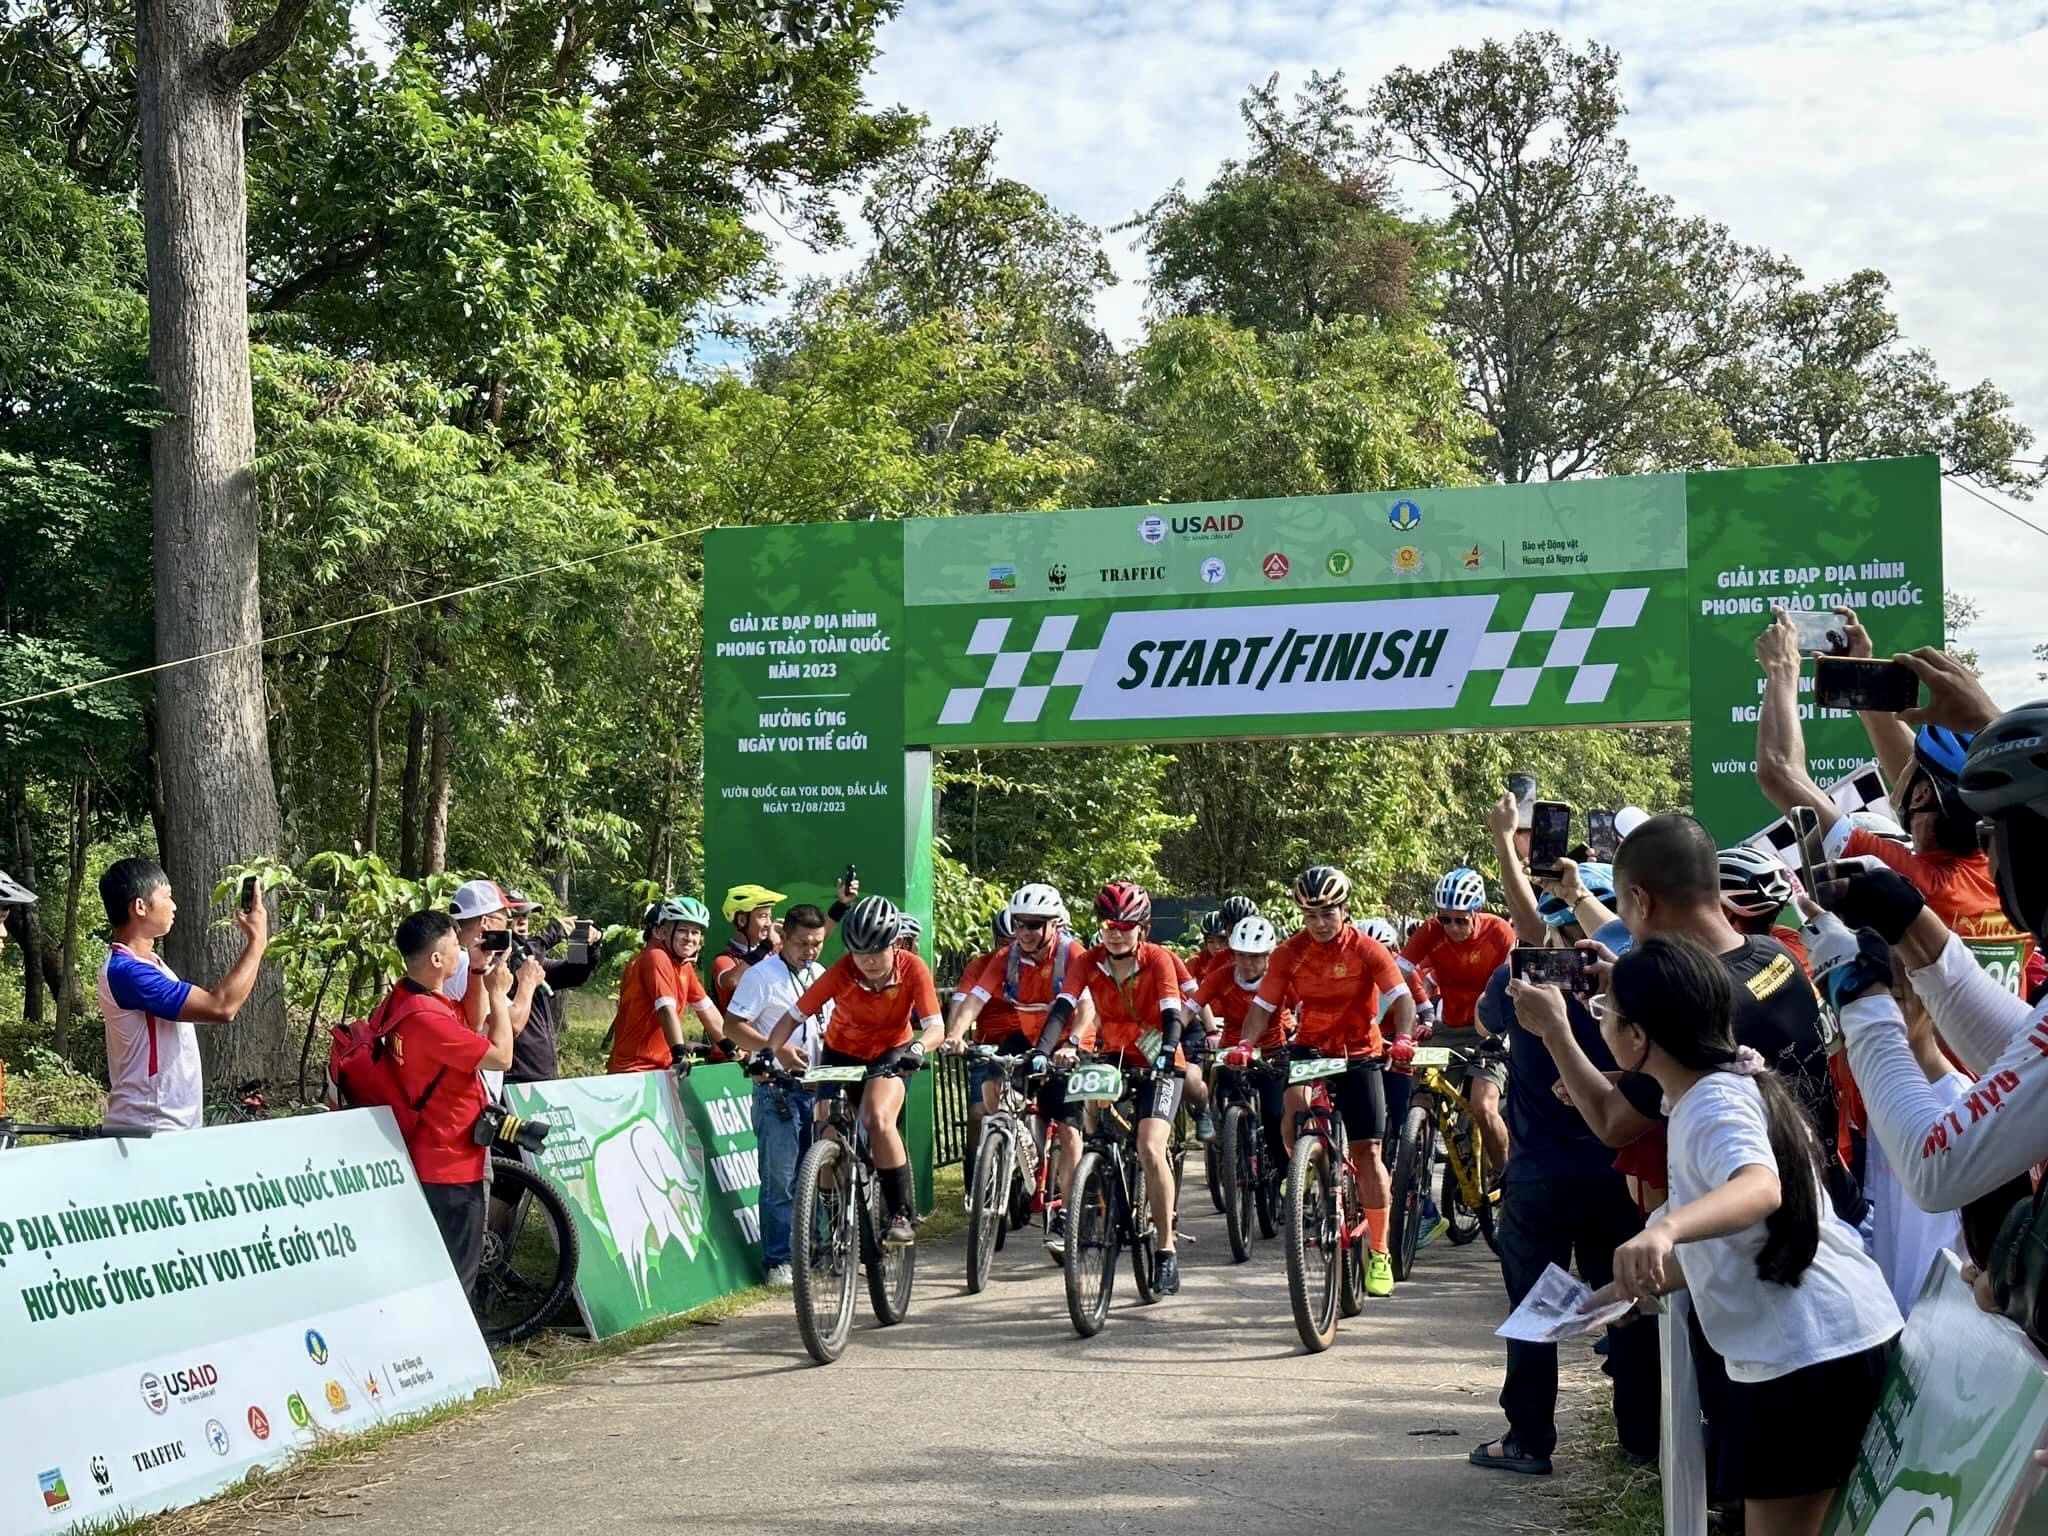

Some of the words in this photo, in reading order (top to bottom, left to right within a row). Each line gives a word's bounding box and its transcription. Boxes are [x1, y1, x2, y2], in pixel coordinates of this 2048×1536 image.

[1171, 514, 1244, 534] USAID
[1100, 566, 1166, 582] TRAFFIC
[1718, 565, 1753, 588] GIẢI
[1758, 569, 1779, 586] XE
[1784, 567, 1820, 589] ĐẠP
[1825, 565, 1856, 586] ĐỊA
[1860, 558, 1904, 580] HÌNH
[1701, 597, 1763, 616] PHONG
[1819, 588, 1867, 608] TOÀN
[1871, 581, 1923, 609] QUỐC
[730, 612, 758, 633] GIẢI
[762, 616, 778, 631] XE
[782, 615, 811, 634] ĐẠP
[814, 614, 839, 633] ĐỊA
[842, 609, 877, 628] HÌNH
[716, 641, 765, 657] PHONG
[768, 636, 806, 655] TRÀO
[810, 634, 847, 653] TOÀN
[850, 629, 891, 654] QUỐC
[769, 660, 800, 679] NĂM
[803, 663, 837, 678] 2023
[1116, 628, 1449, 691] START/FINISH
[759, 707, 811, 728] HƯỞNG
[815, 707, 846, 726] ỨNG
[738, 734, 776, 753] NGÀY
[779, 737, 803, 751] VOI
[806, 729, 835, 751] THẾ
[836, 731, 868, 750] GIỚI
[1991, 736, 2041, 755] GIRO
[1712, 760, 1746, 774] VƯỜN
[1810, 758, 1835, 770] YOK
[721, 785, 748, 798] VƯỜN
[751, 783, 778, 797] QUỐC
[781, 786, 796, 797] GIA
[799, 786, 818, 796] YOK
[821, 785, 845, 798] DON,
[763, 801, 788, 813] NGÀY
[791, 801, 846, 813] 12/08/2023
[1068, 1072, 1116, 1094] 081
[16, 1214, 63, 1260] ĐỊA
[58, 1199, 116, 1244] HÌNH
[112, 1195, 187, 1236] PHONG
[182, 1179, 237, 1222] TRÀO
[234, 1171, 288, 1214] TOÀN
[284, 1157, 334, 1208] QUỐC
[329, 1158, 370, 1196] NĂM
[365, 1158, 405, 1190] 2023
[21, 1268, 107, 1323] HƯỞNG
[103, 1260, 155, 1305] ỨNG
[151, 1248, 208, 1295] NGÀY
[206, 1248, 245, 1282] VOI
[240, 1223, 281, 1275] THẾ
[278, 1224, 320, 1267] GIỚI
[317, 1222, 357, 1258] 12/8
[163, 1363, 218, 1396] USAID
[132, 1440, 186, 1472] TRAFFIC
[98, 1485, 114, 1497] WWF
